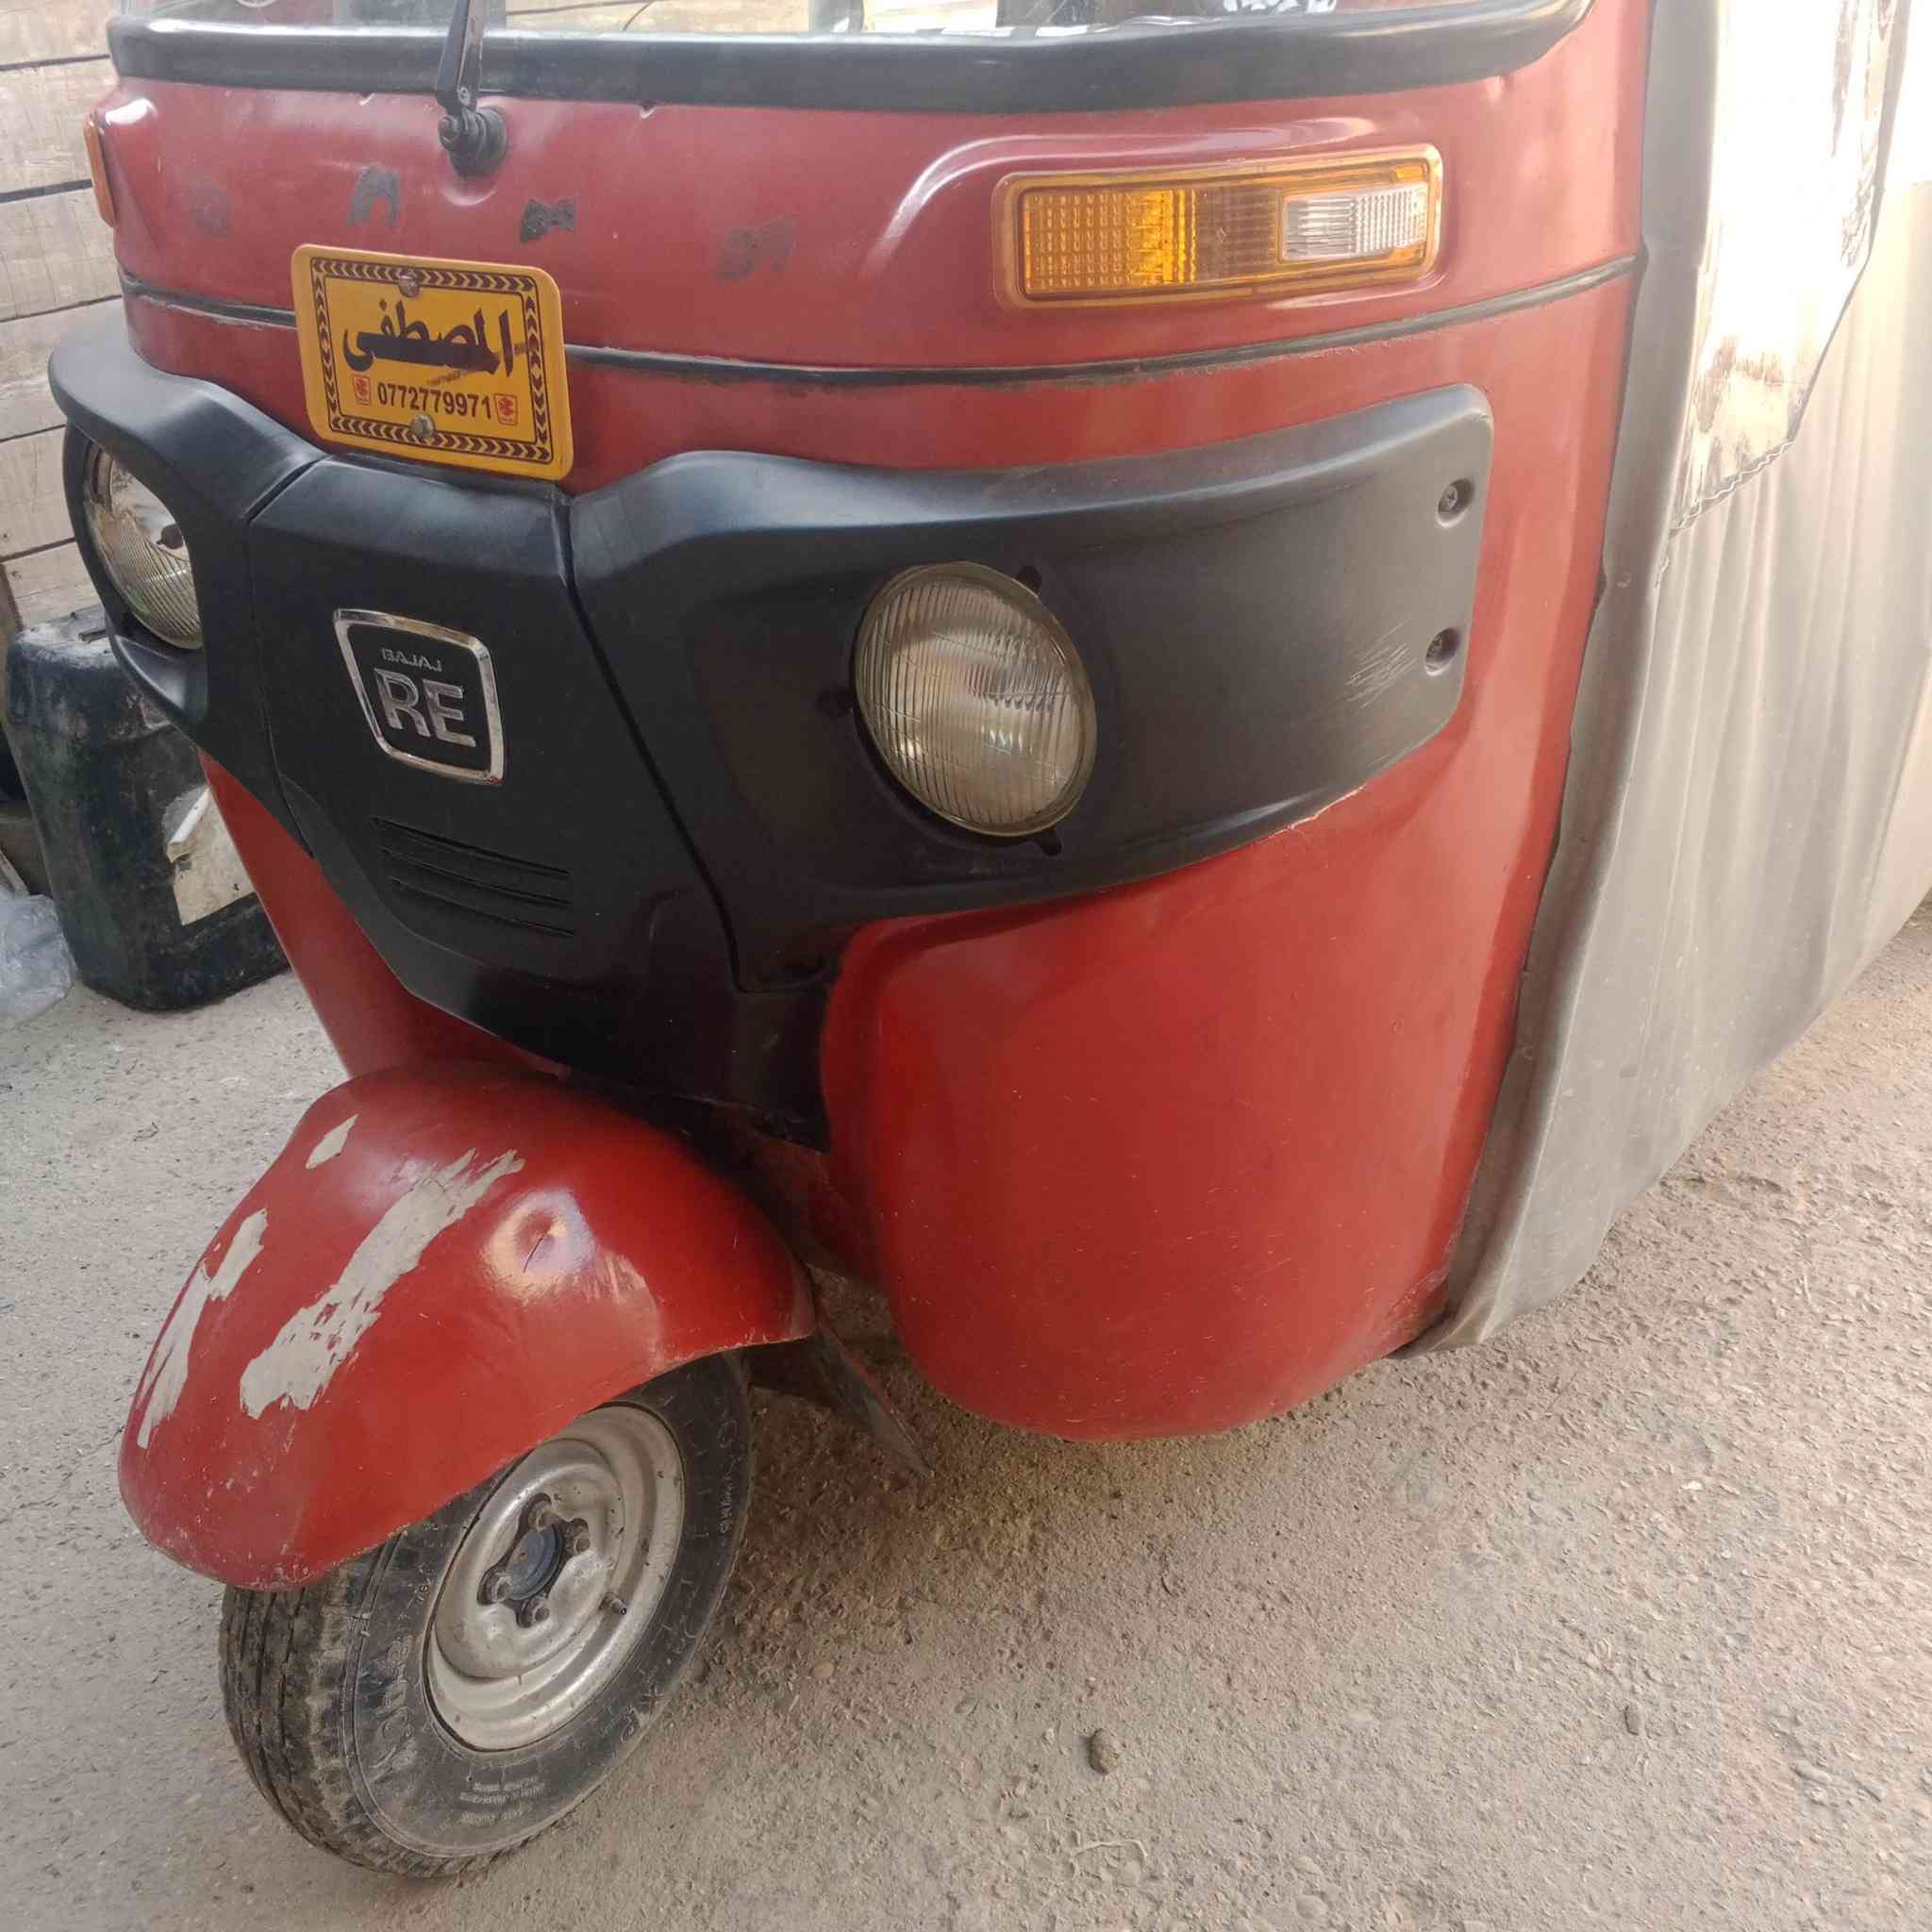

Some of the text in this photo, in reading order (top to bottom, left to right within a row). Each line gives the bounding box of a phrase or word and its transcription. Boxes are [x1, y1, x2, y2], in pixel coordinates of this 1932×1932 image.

[342, 299, 514, 377] المصطفى
[377, 382, 492, 420] 0772779971
[381, 648, 442, 672] BAJAJ
[374, 668, 475, 747] RE
